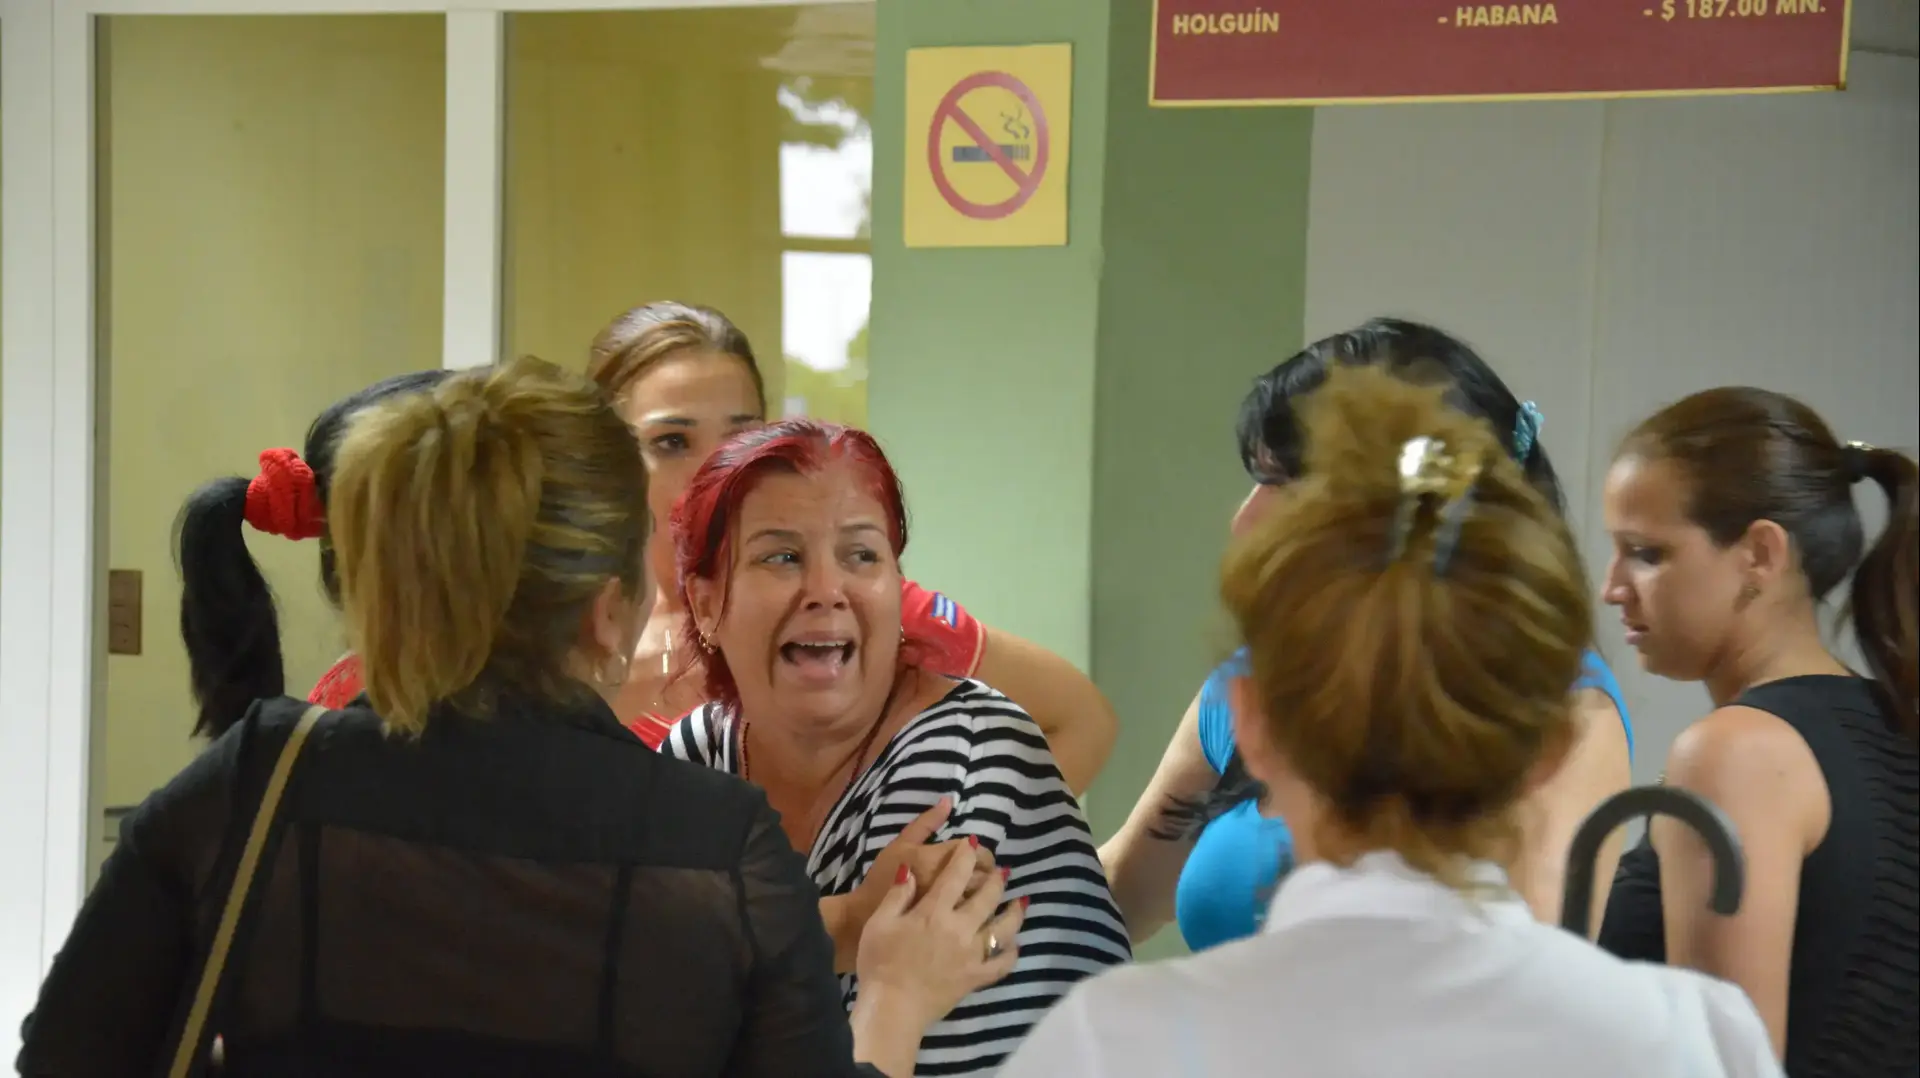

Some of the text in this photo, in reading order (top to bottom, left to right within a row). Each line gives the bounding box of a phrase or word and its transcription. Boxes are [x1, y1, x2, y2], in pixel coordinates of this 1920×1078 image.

[1172, 8, 1280, 34] HOLGUÍN
[1455, 3, 1558, 27] HABANA
[1661, 0, 1676, 22] $
[1685, 0, 1768, 18] 187.00
[1775, 0, 1827, 15] MN.
